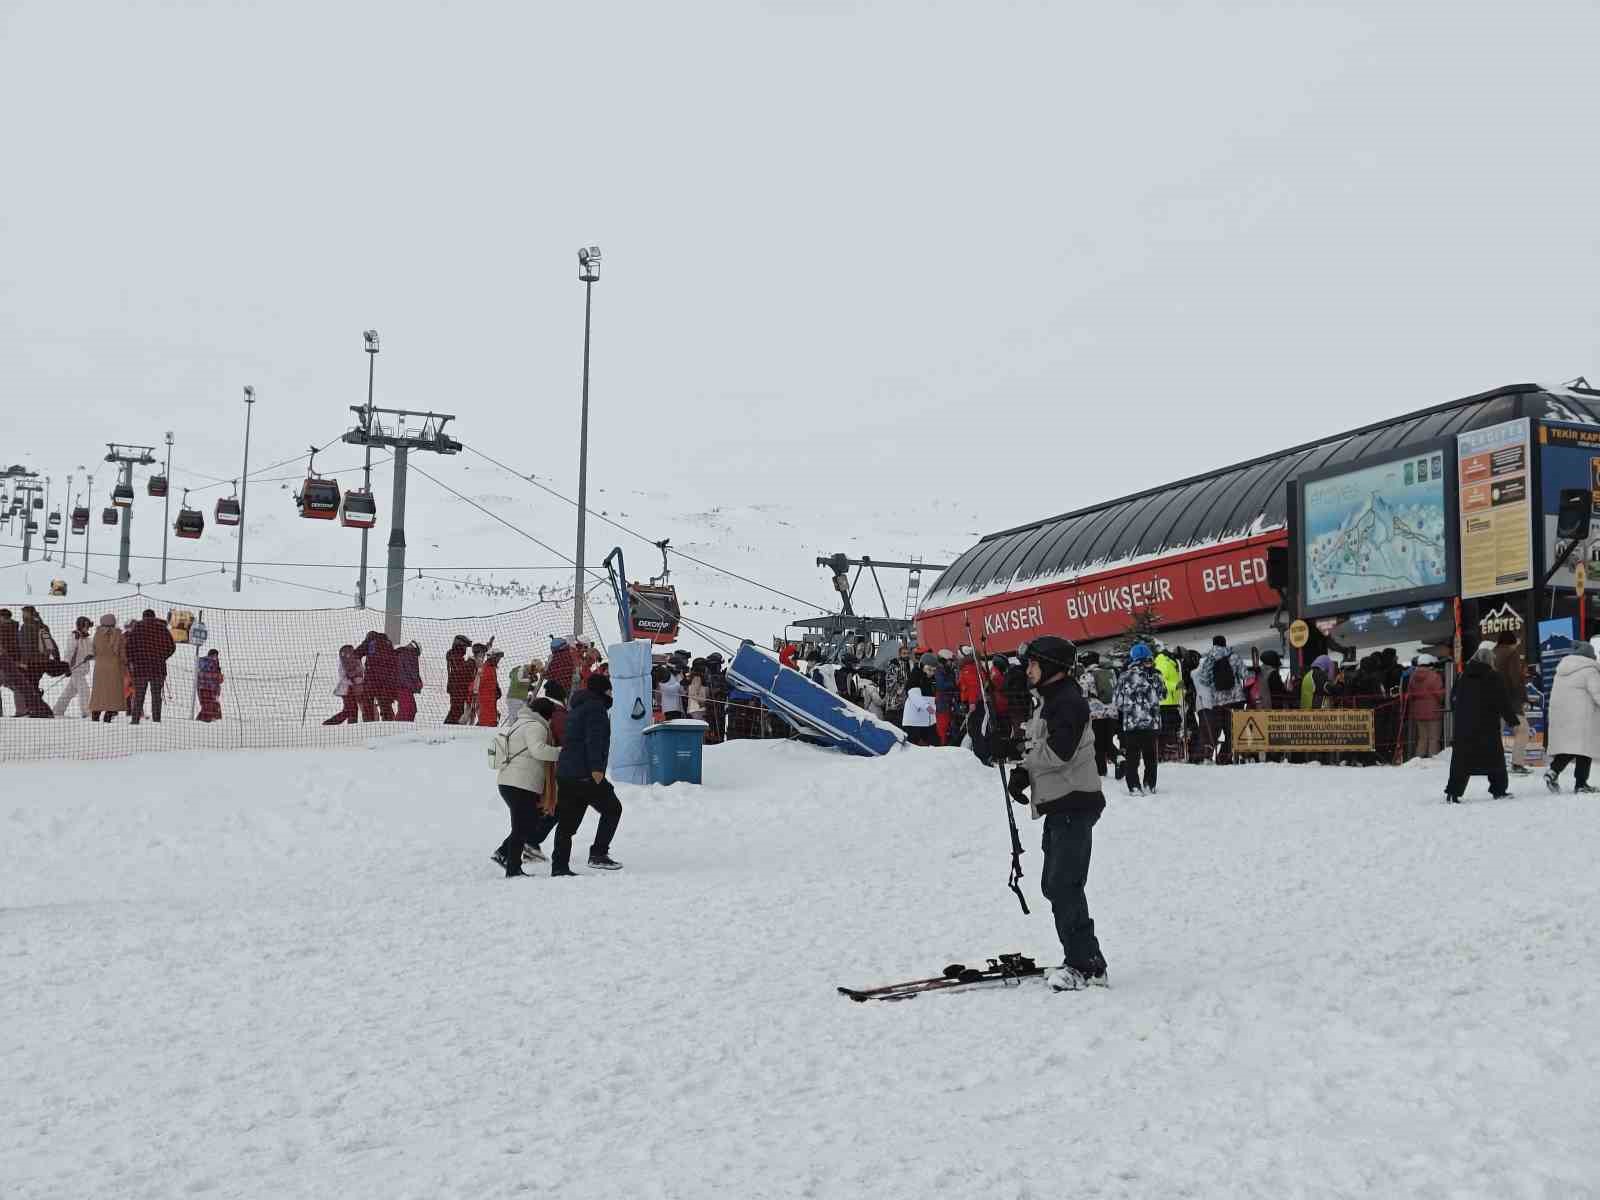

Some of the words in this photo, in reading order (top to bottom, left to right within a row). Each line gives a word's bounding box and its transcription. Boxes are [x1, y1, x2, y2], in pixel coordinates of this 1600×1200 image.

[984, 600, 1044, 635] KAYSERİ
[1067, 575, 1174, 620] BÜYÜKŞEHİR
[1203, 556, 1268, 592] BELED
